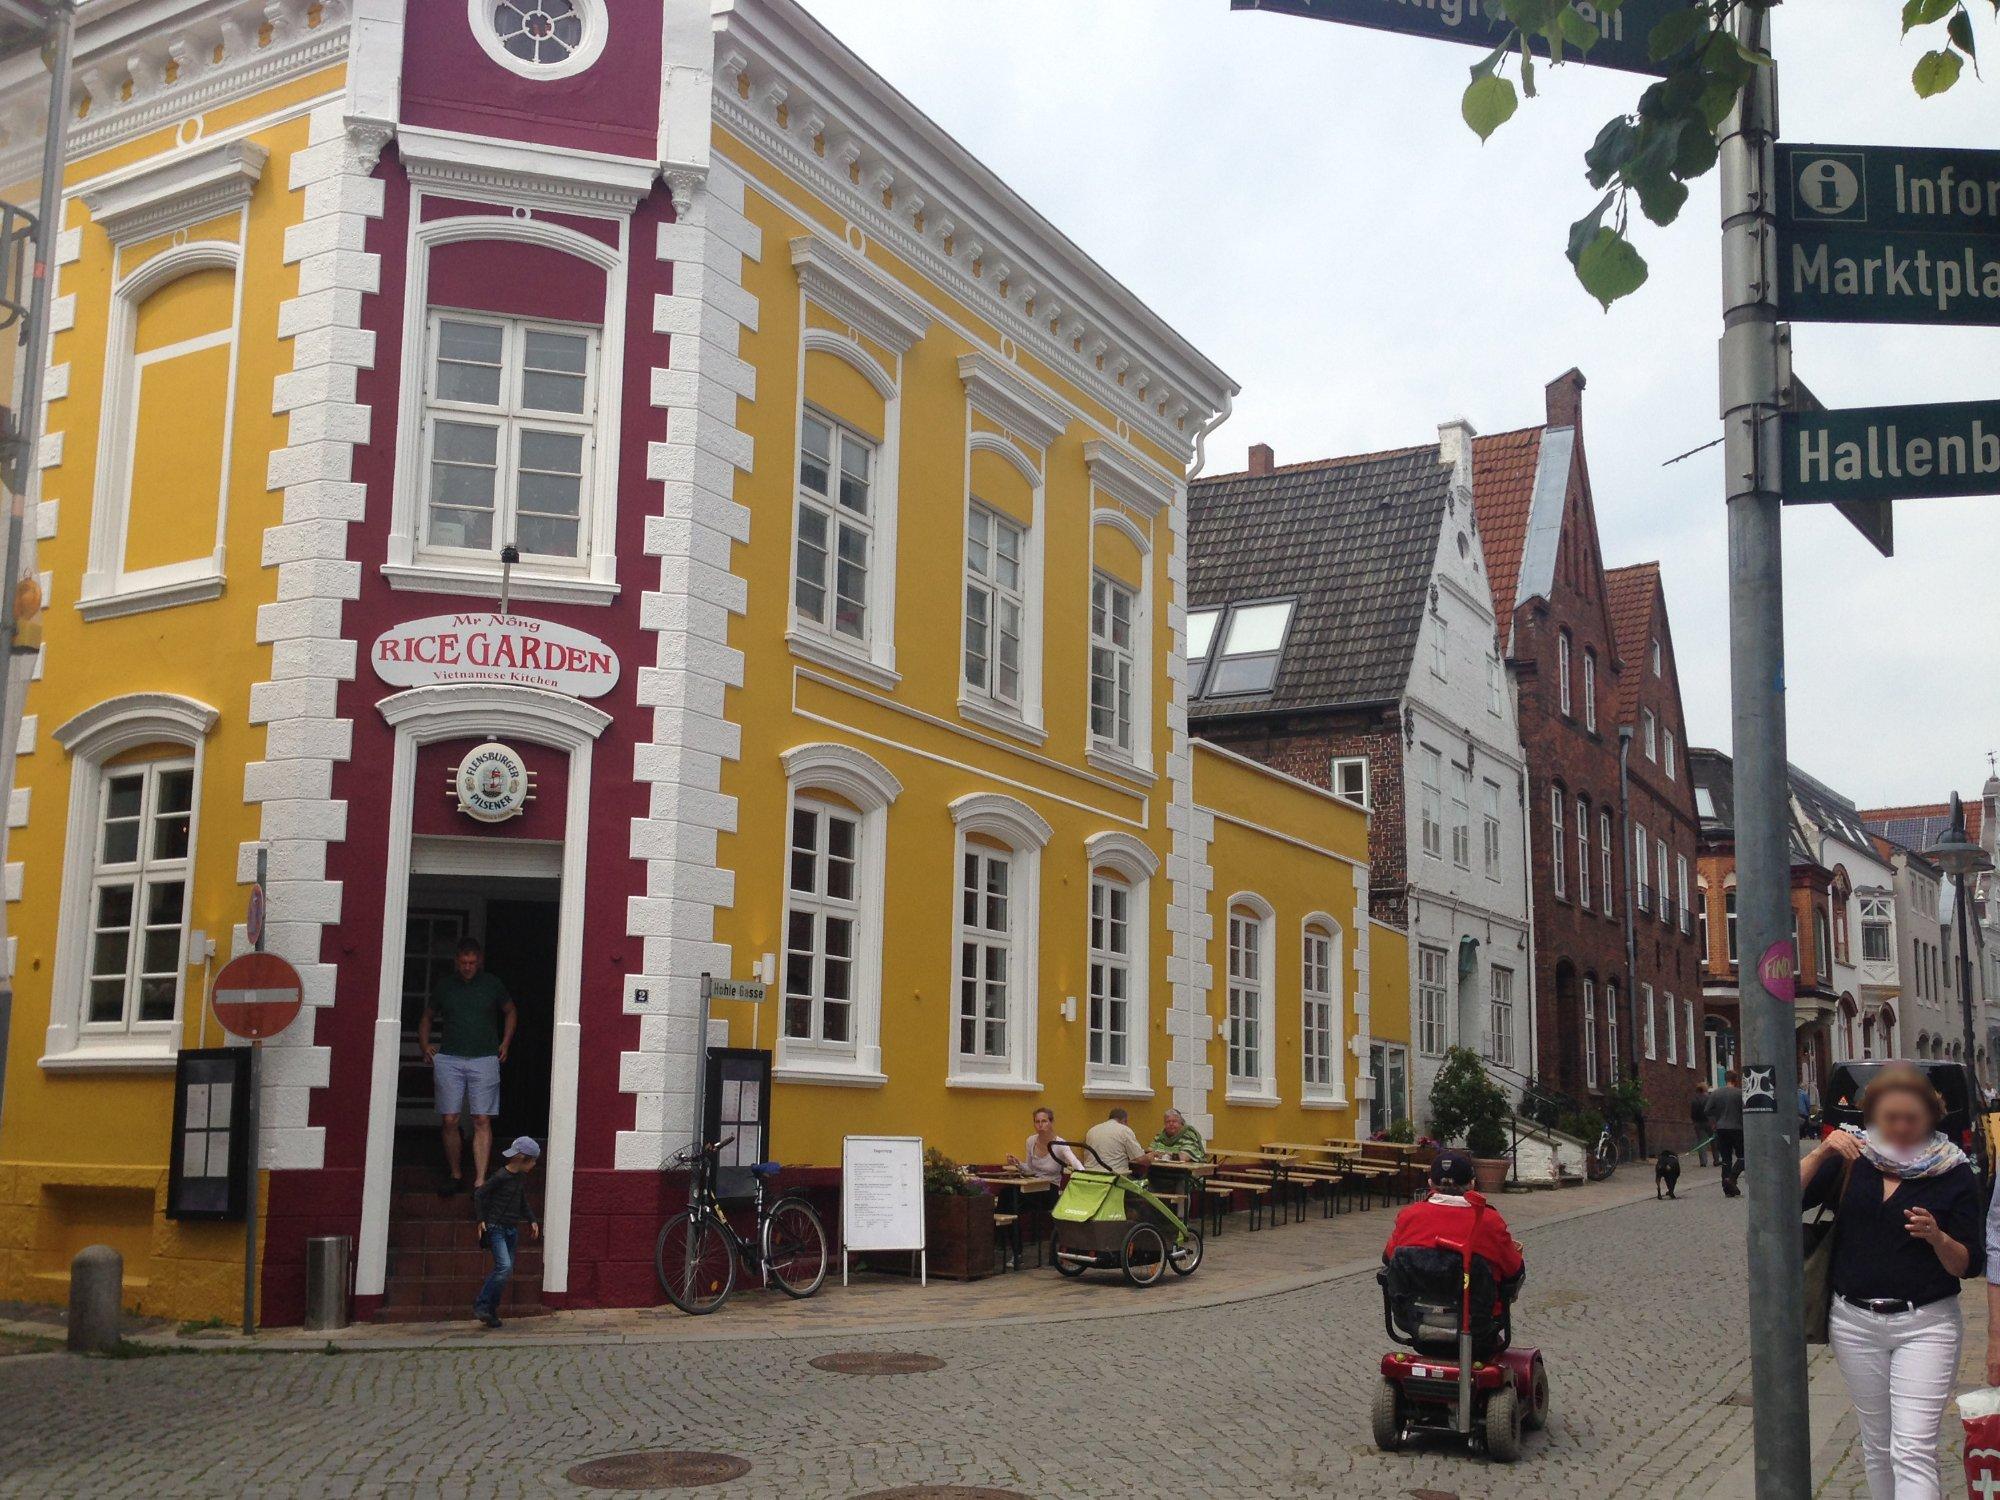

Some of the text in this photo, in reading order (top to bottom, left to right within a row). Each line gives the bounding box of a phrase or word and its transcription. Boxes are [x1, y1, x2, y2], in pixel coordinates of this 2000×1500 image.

[1792, 243, 2000, 311] Marktpla
[1799, 420, 2000, 483] Hallenb
[452, 614, 482, 628] Mr
[378, 632, 612, 675] RICE GARDEN
[433, 670, 558, 688] Vietnamese Kitchen
[466, 752, 519, 779] FLENSBURGER
[470, 793, 513, 811] PILSENER
[637, 990, 647, 1001] 2
[714, 982, 763, 999] Hohle Gasse
